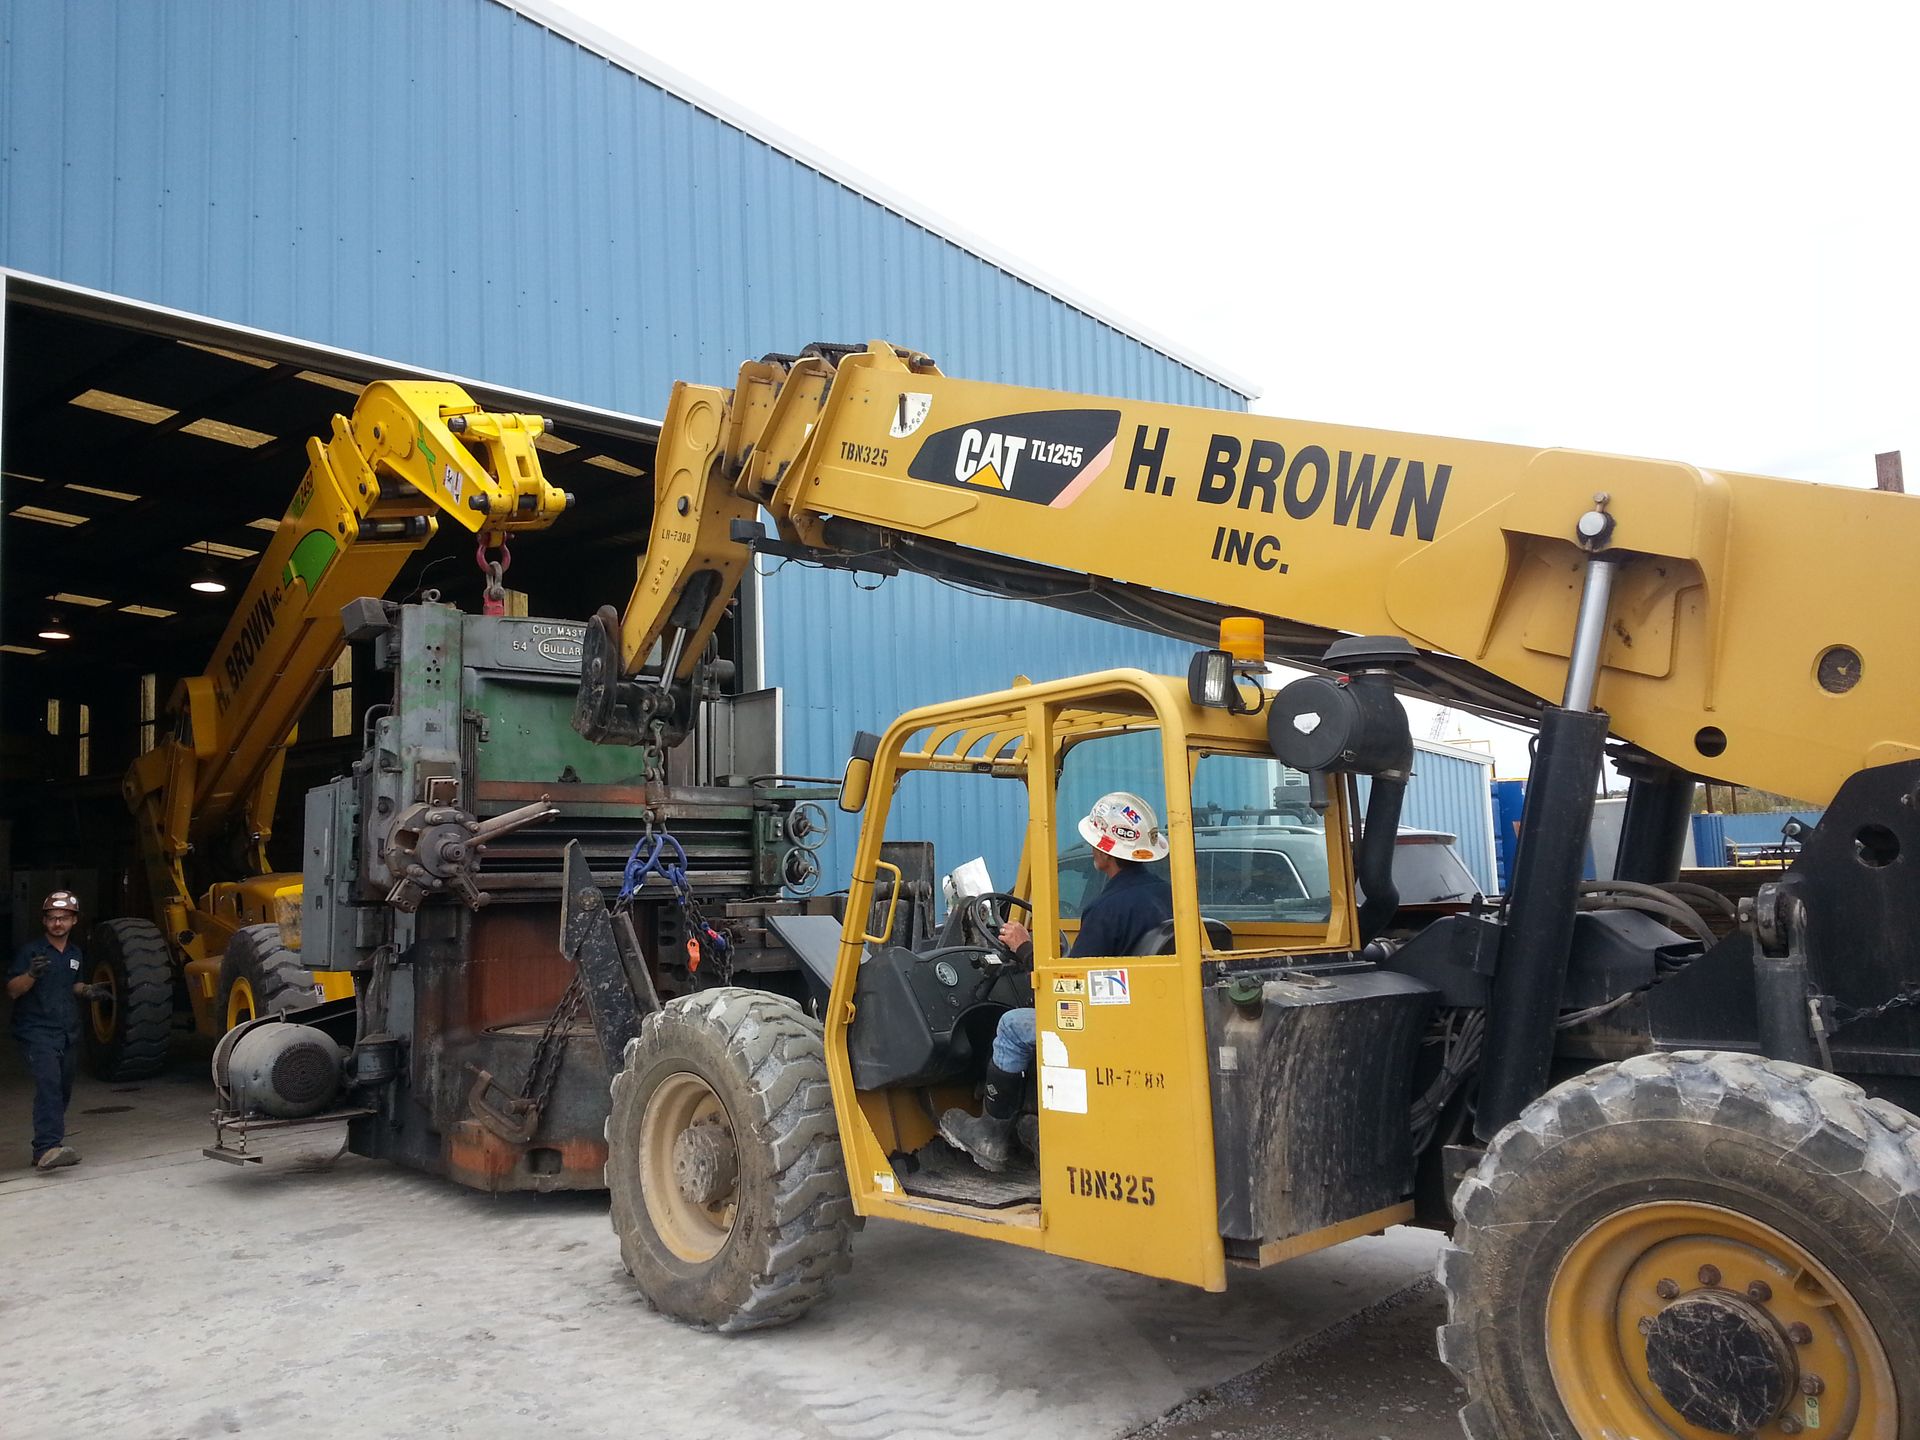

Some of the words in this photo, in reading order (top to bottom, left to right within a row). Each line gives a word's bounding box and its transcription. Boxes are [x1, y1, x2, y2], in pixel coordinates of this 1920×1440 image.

[840, 441, 889, 467] TBN325
[954, 428, 1027, 491] CAT
[1030, 439, 1084, 468] TL1255
[1123, 424, 1176, 496] H.
[1197, 433, 1453, 542] BROWN
[1210, 526, 1289, 575] INC.
[225, 589, 275, 694] BROWN
[532, 624, 553, 635] CUT
[543, 643, 584, 656] BULLAR
[1066, 1166, 1155, 1206] TBN325
